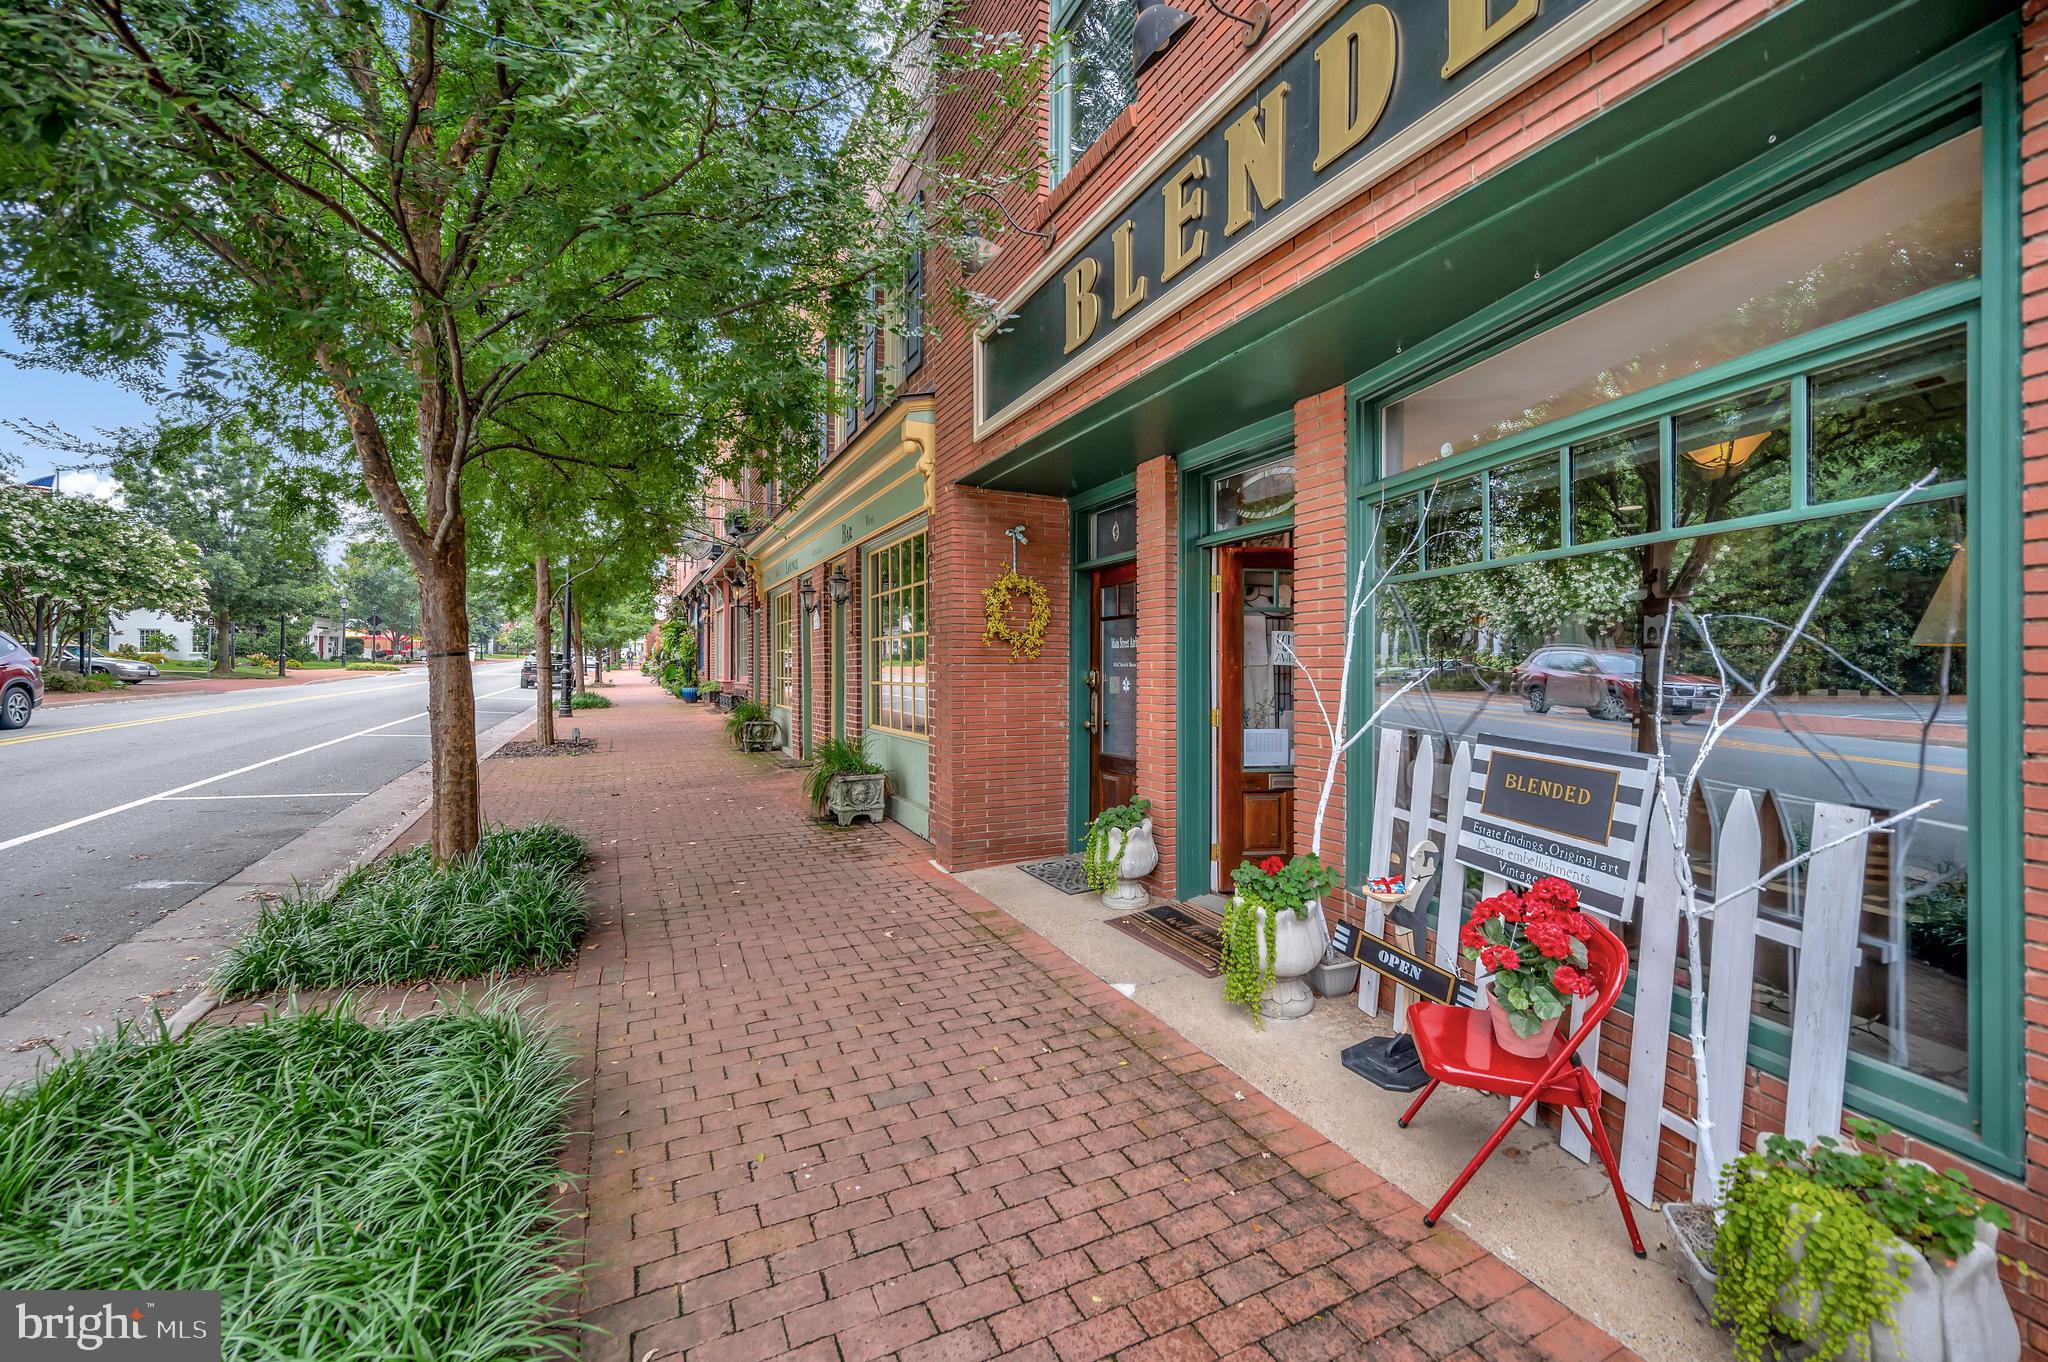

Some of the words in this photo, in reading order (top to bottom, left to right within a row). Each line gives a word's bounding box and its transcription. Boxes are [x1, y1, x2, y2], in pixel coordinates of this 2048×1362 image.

[1504, 772, 1592, 806] BLENDED
[1473, 821, 1502, 841] Estate
[1600, 860, 1620, 876] art
[1477, 838, 1506, 857] Decor
[1507, 850, 1591, 885] embellishments
[1498, 860, 1539, 885] Vintage
[1378, 949, 1423, 981] OPEN
